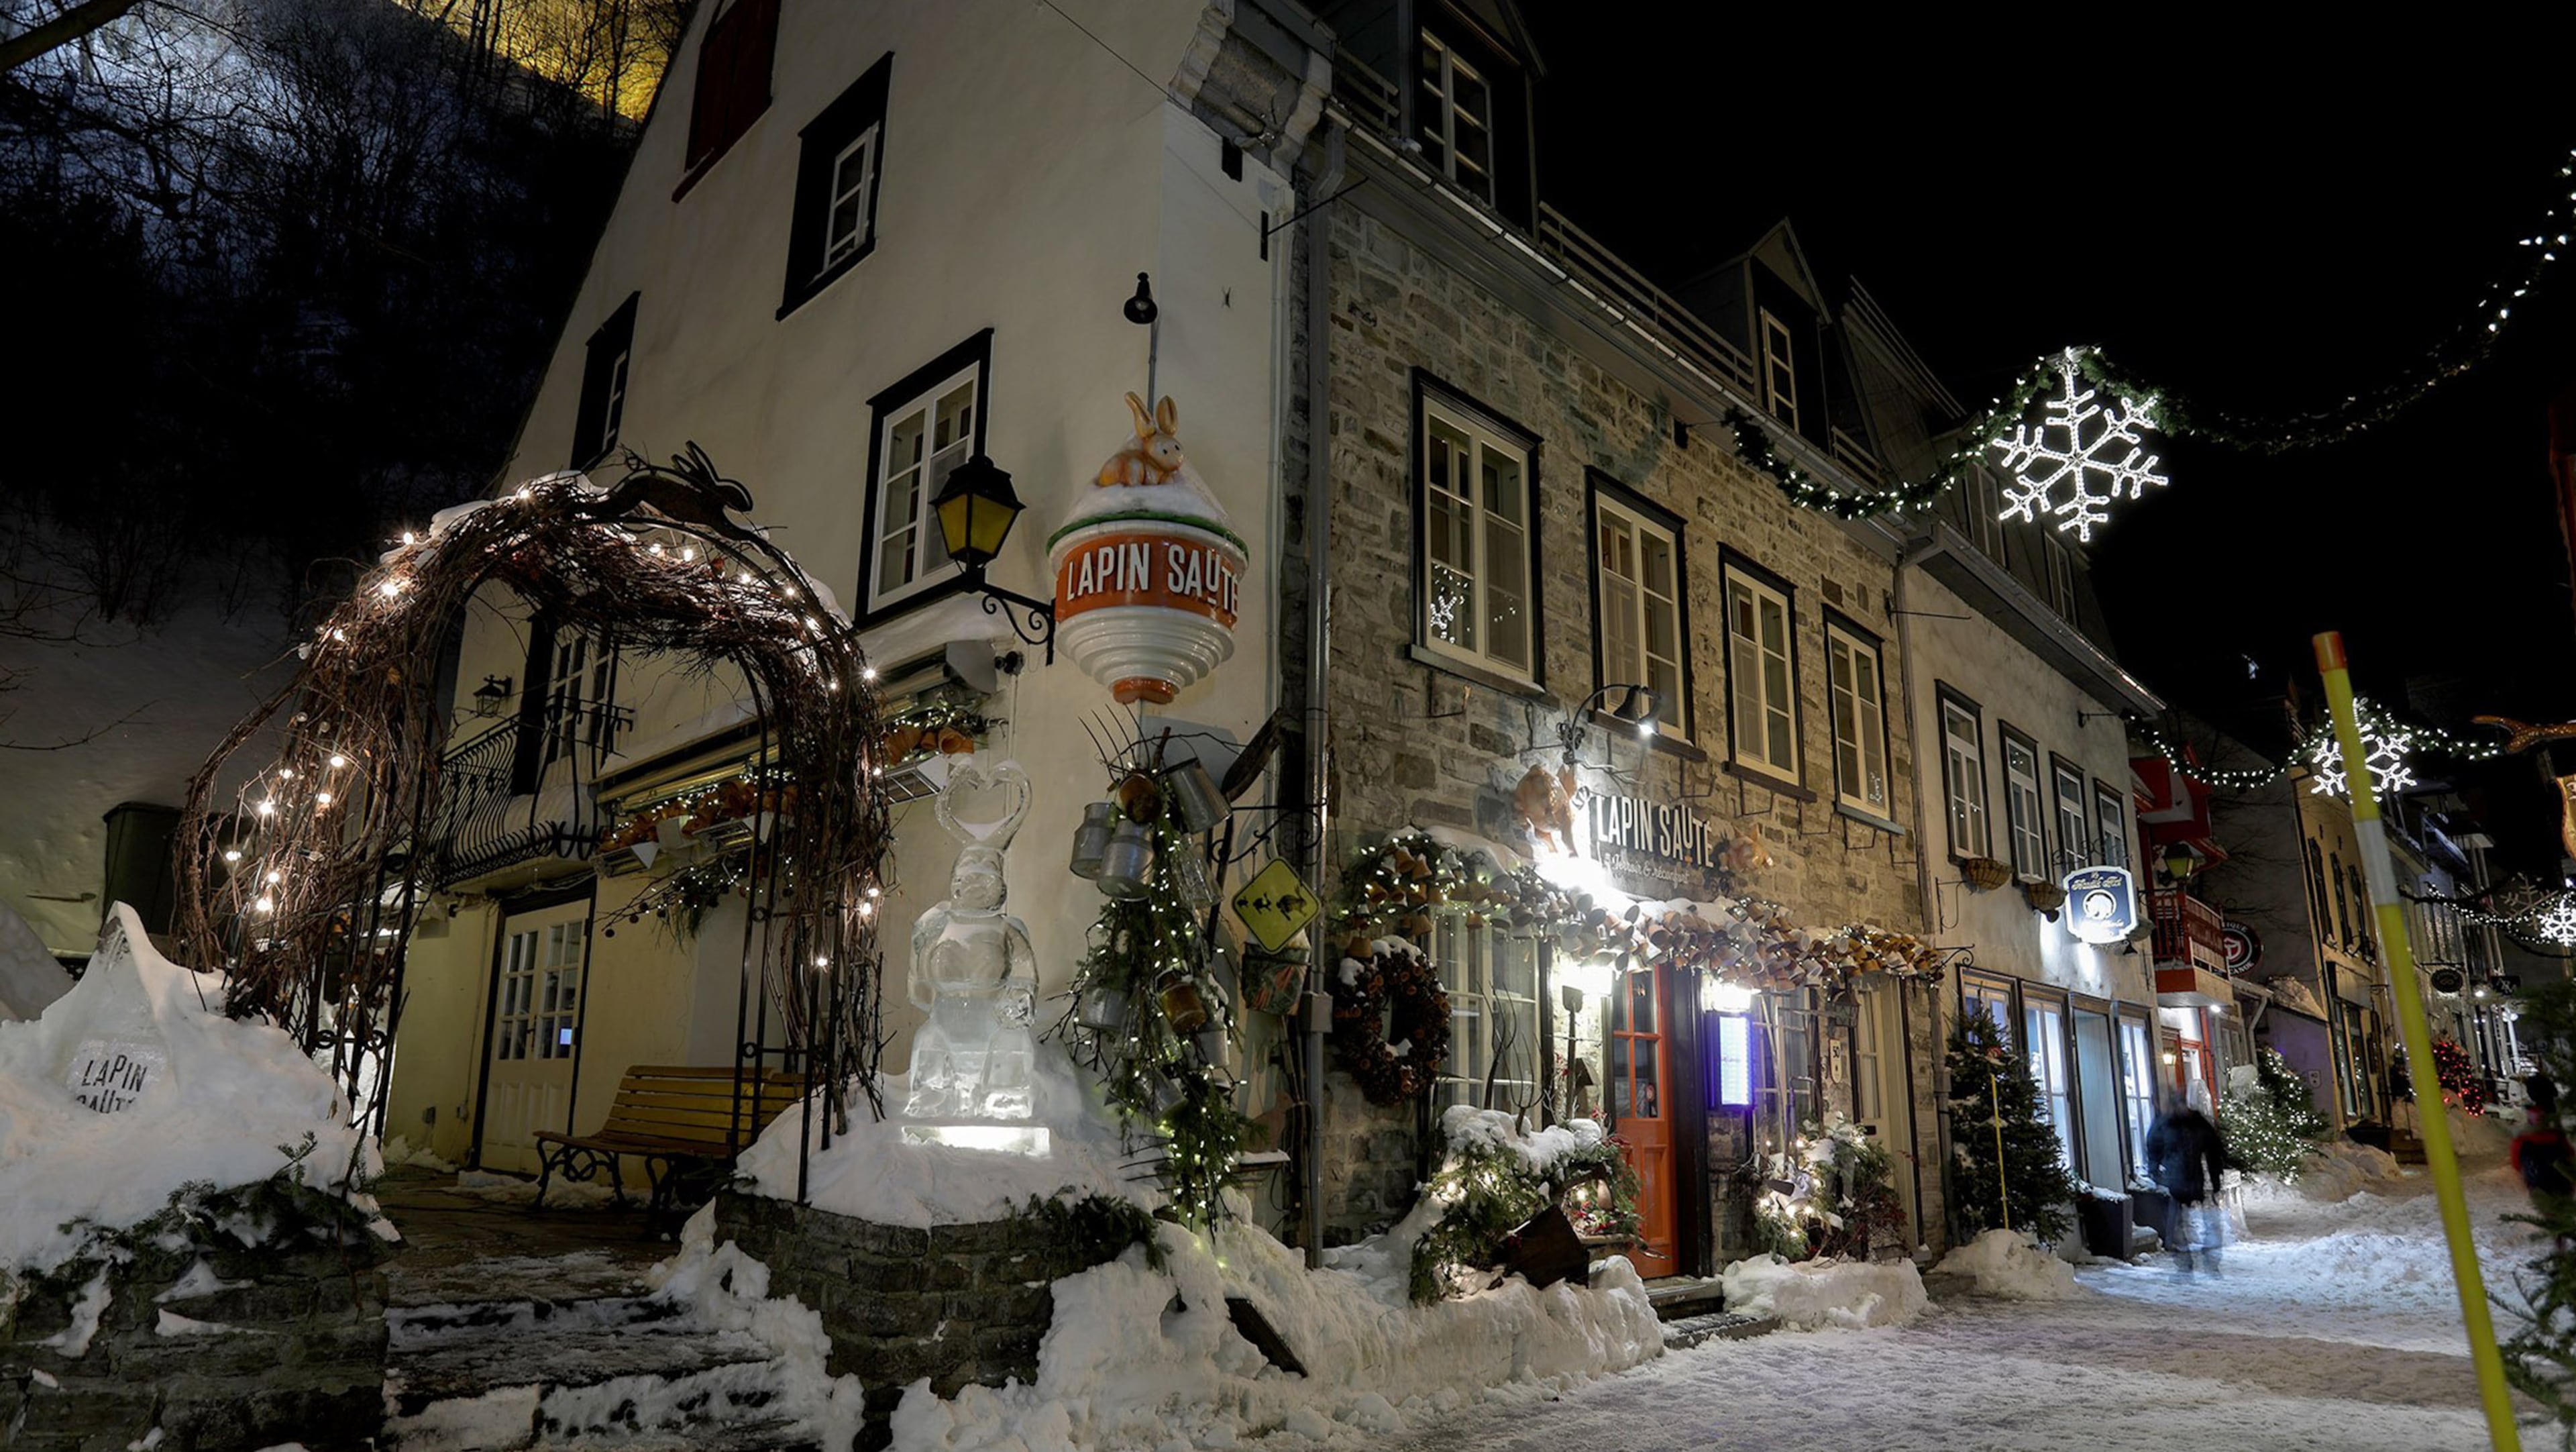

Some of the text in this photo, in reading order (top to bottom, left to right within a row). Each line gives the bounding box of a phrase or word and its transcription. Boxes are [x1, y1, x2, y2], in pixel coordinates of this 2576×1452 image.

[1067, 542, 1150, 602] LAPIN
[1596, 795, 1714, 868] LAPIN SAUTÉ
[81, 1054, 147, 1092] LAPIN
